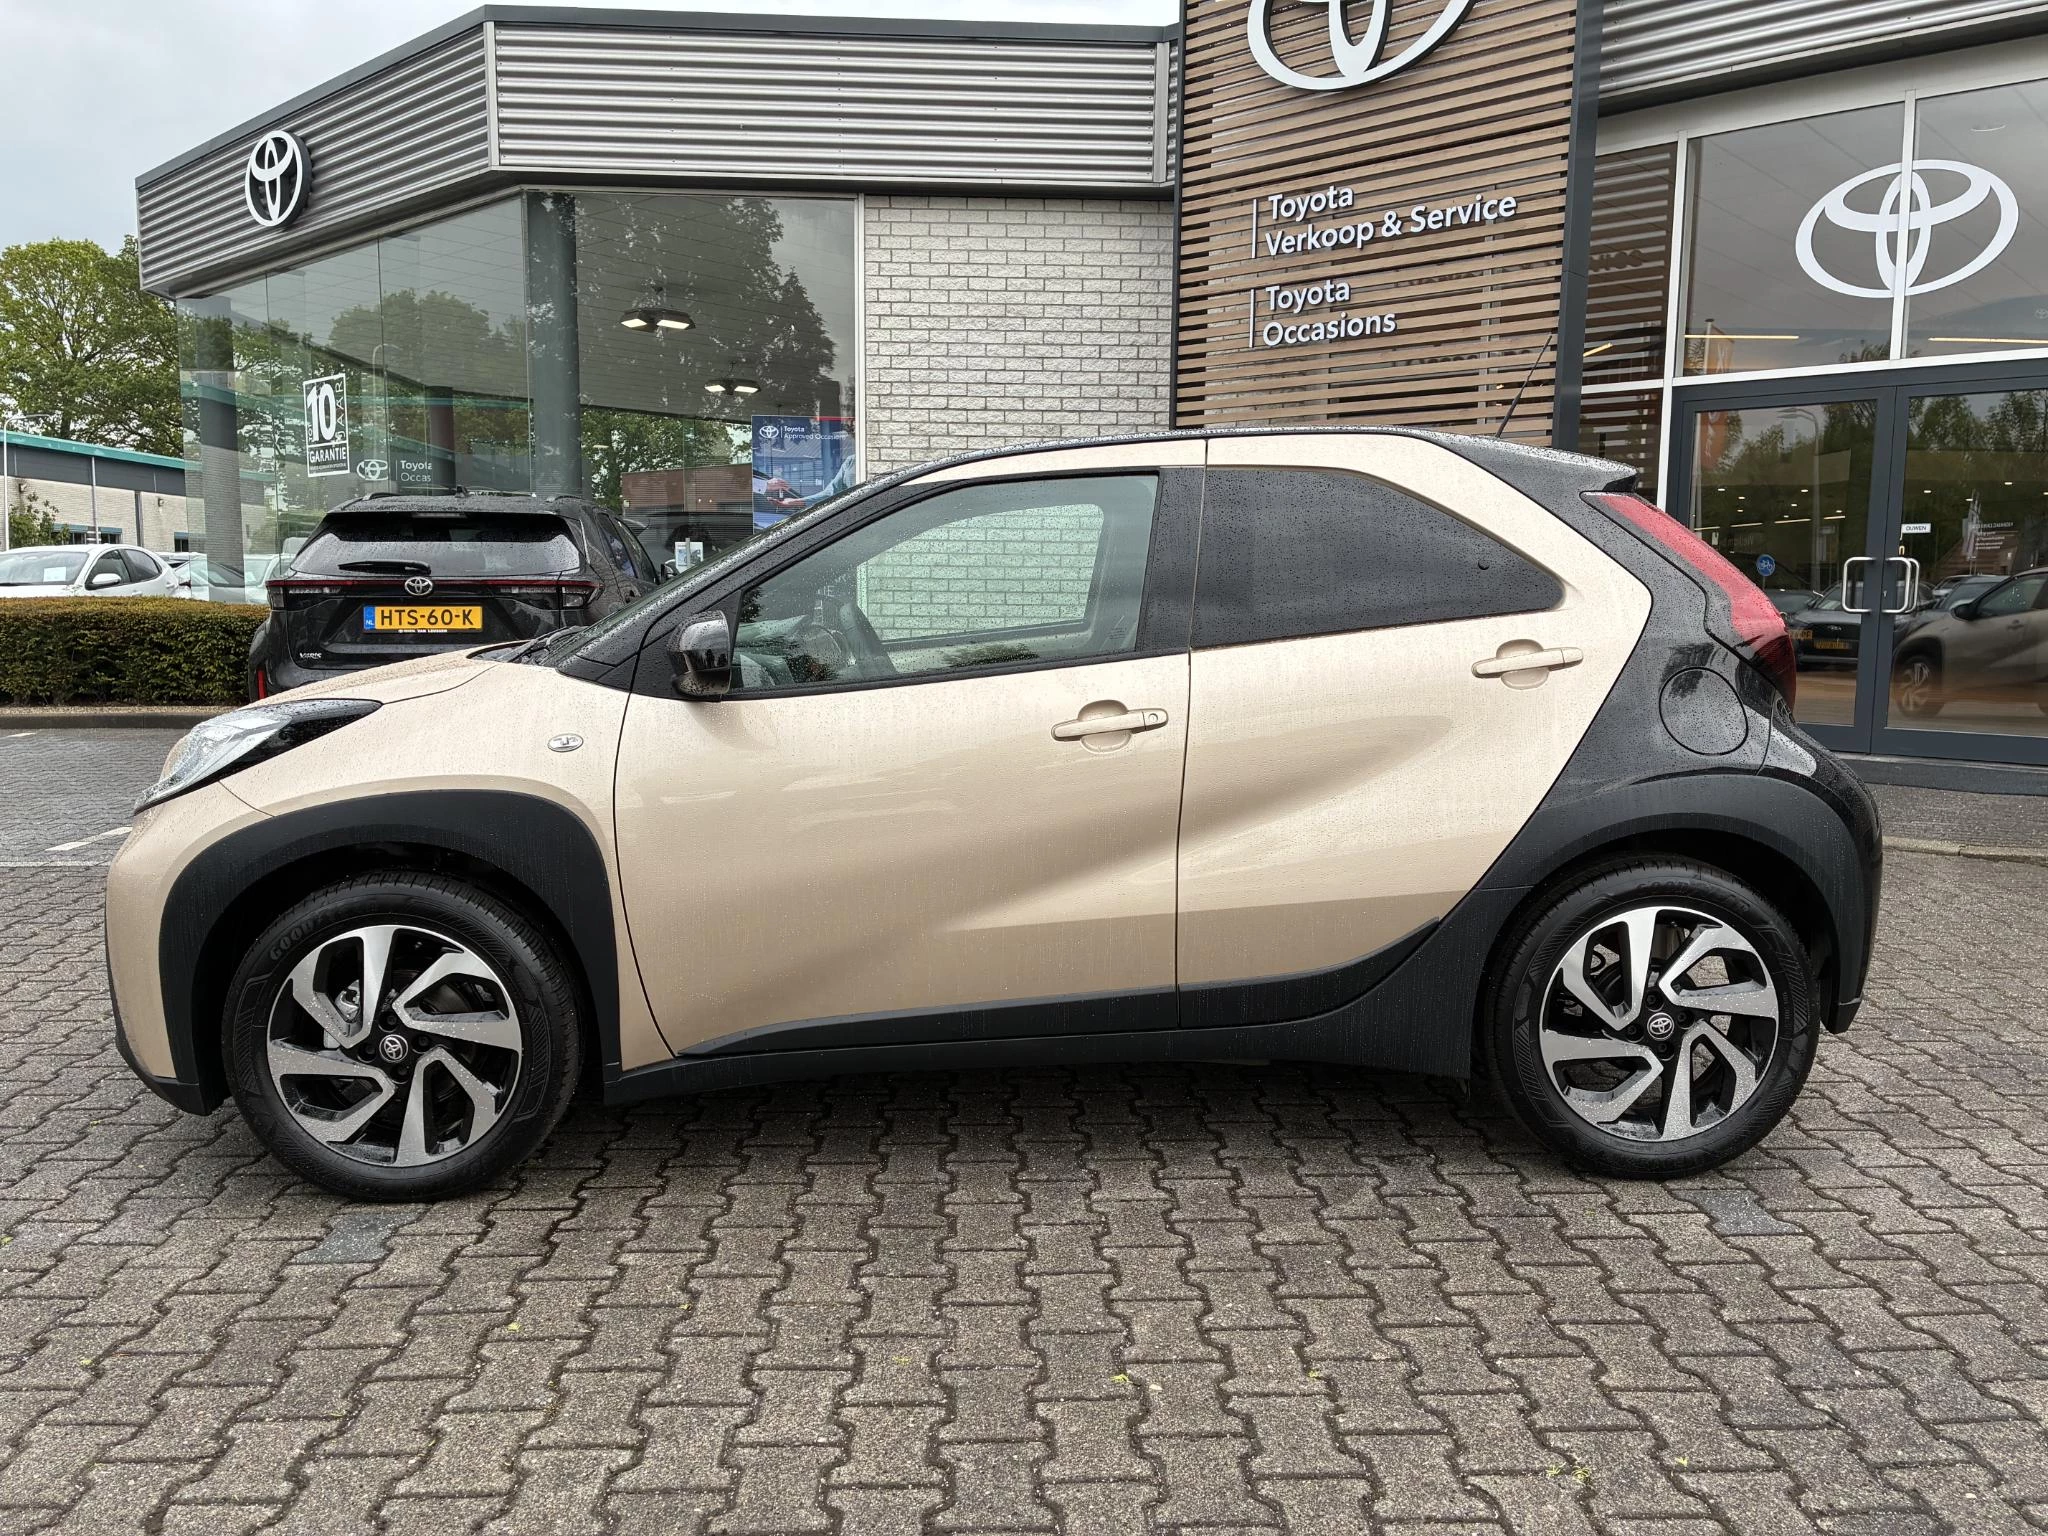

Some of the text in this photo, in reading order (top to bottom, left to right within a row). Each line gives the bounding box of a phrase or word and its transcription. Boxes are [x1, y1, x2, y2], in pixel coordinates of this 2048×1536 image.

[1268, 185, 1354, 222] Toyota
[1265, 194, 1517, 257] Verkoop & Service
[1265, 280, 1351, 314] Toyota
[1262, 312, 1396, 347] Occasions
[306, 383, 337, 442] 10
[309, 446, 347, 464] GARANTIE
[400, 460, 432, 472] Toyota
[380, 609, 474, 626] HTS-60-K
